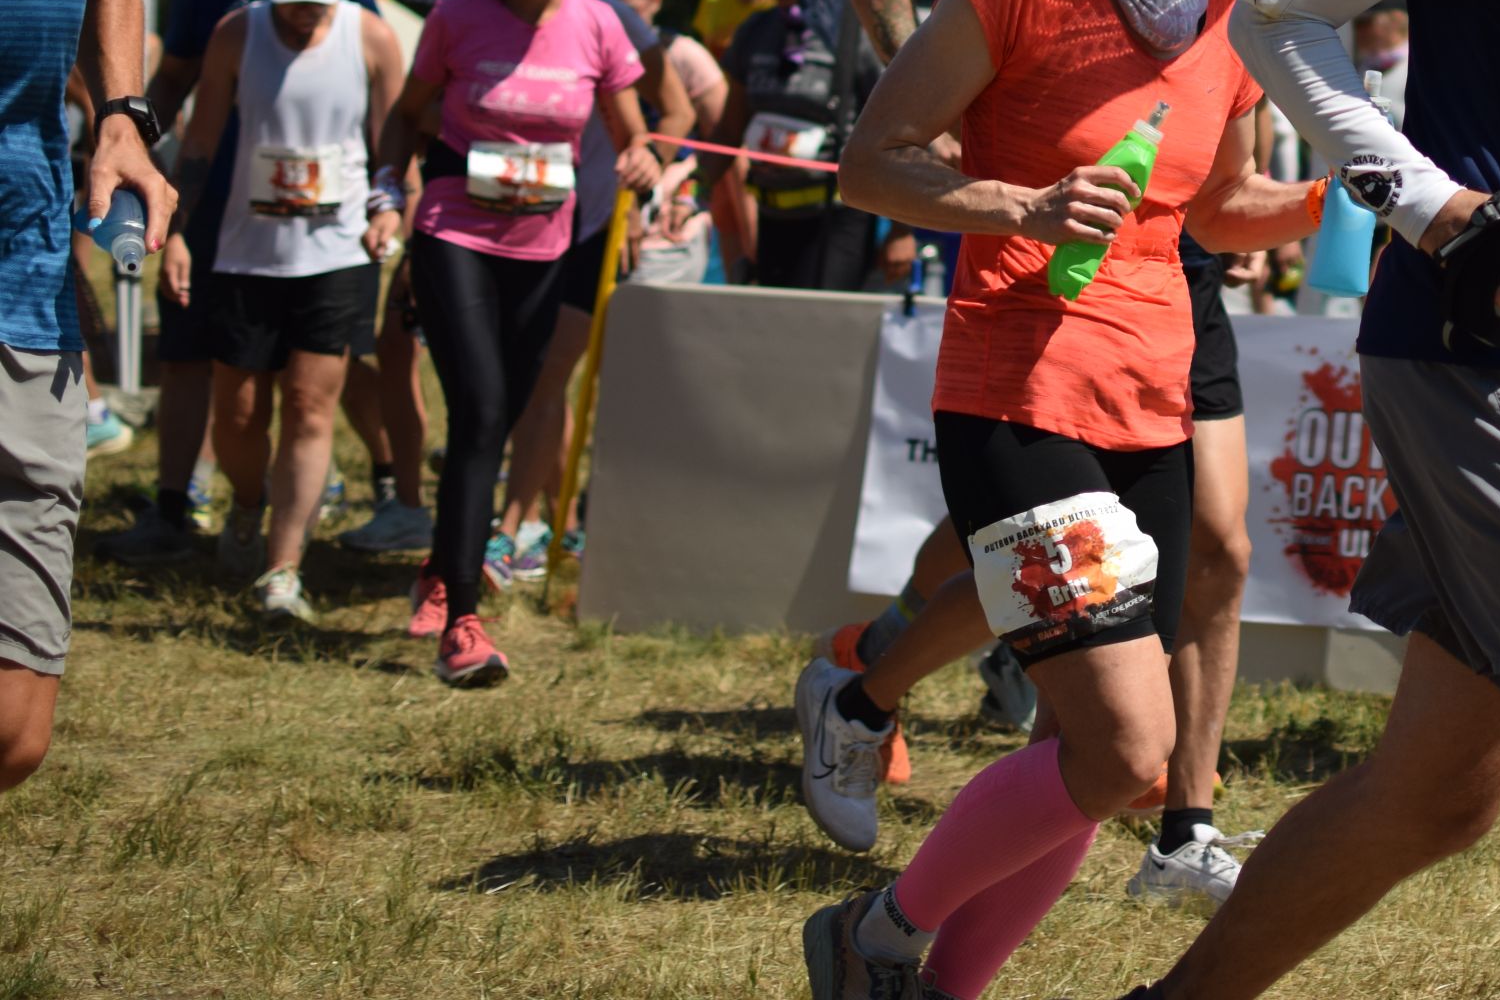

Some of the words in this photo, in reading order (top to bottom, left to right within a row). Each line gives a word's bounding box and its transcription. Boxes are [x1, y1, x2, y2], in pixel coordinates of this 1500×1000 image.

[1352, 154, 1386, 166] STATES
[984, 534, 1015, 554] OUTRUN
[1044, 534, 1073, 575] 5
